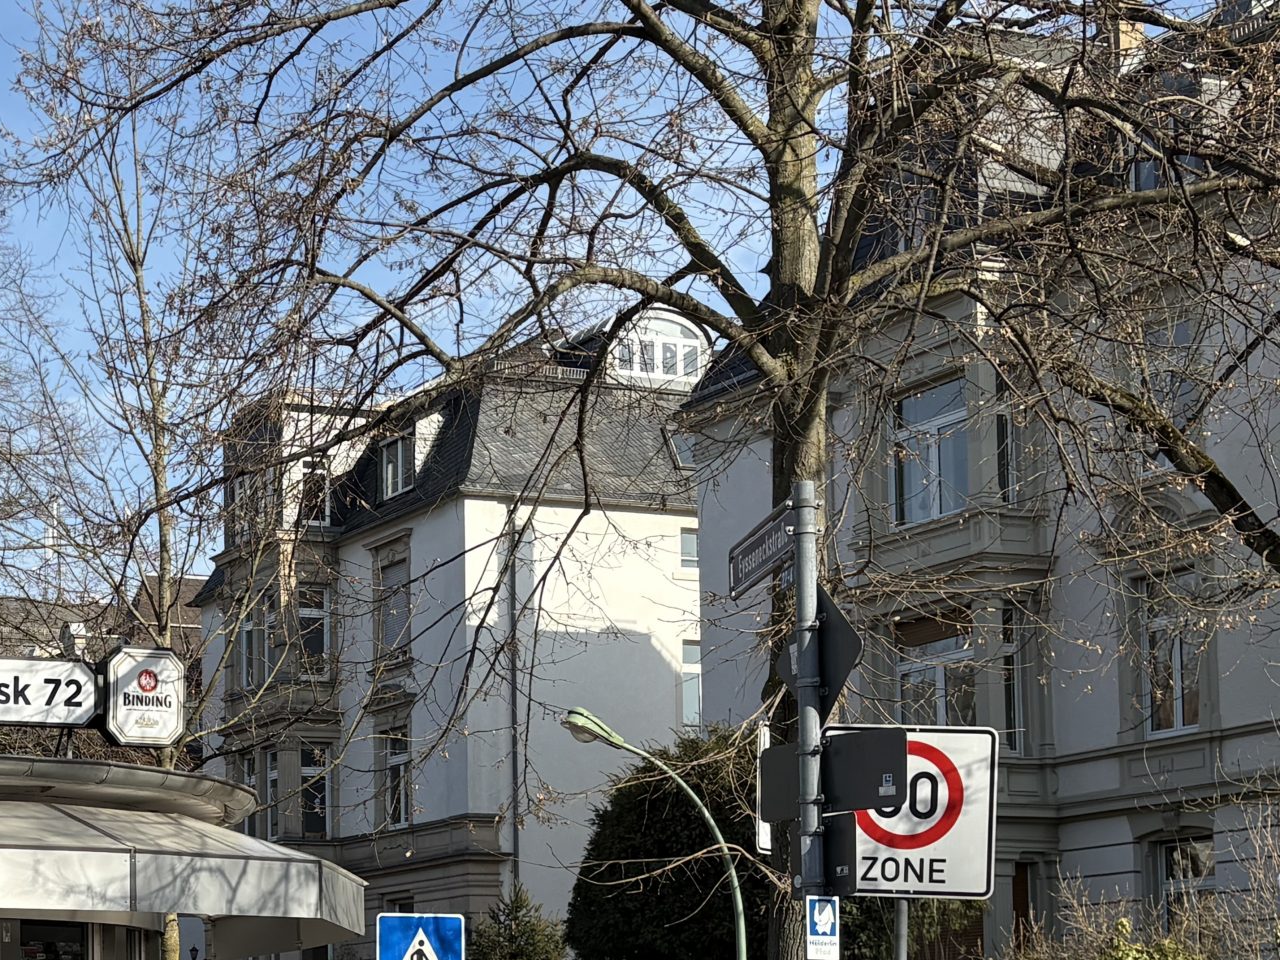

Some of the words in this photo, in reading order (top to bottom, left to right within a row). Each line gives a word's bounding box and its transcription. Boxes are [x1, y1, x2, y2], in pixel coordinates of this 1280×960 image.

[738, 521, 788, 580] Eysseneckstraß
[43, 678, 83, 708] 72
[123, 691, 173, 709] BINDING
[860, 856, 947, 884] ZONE
